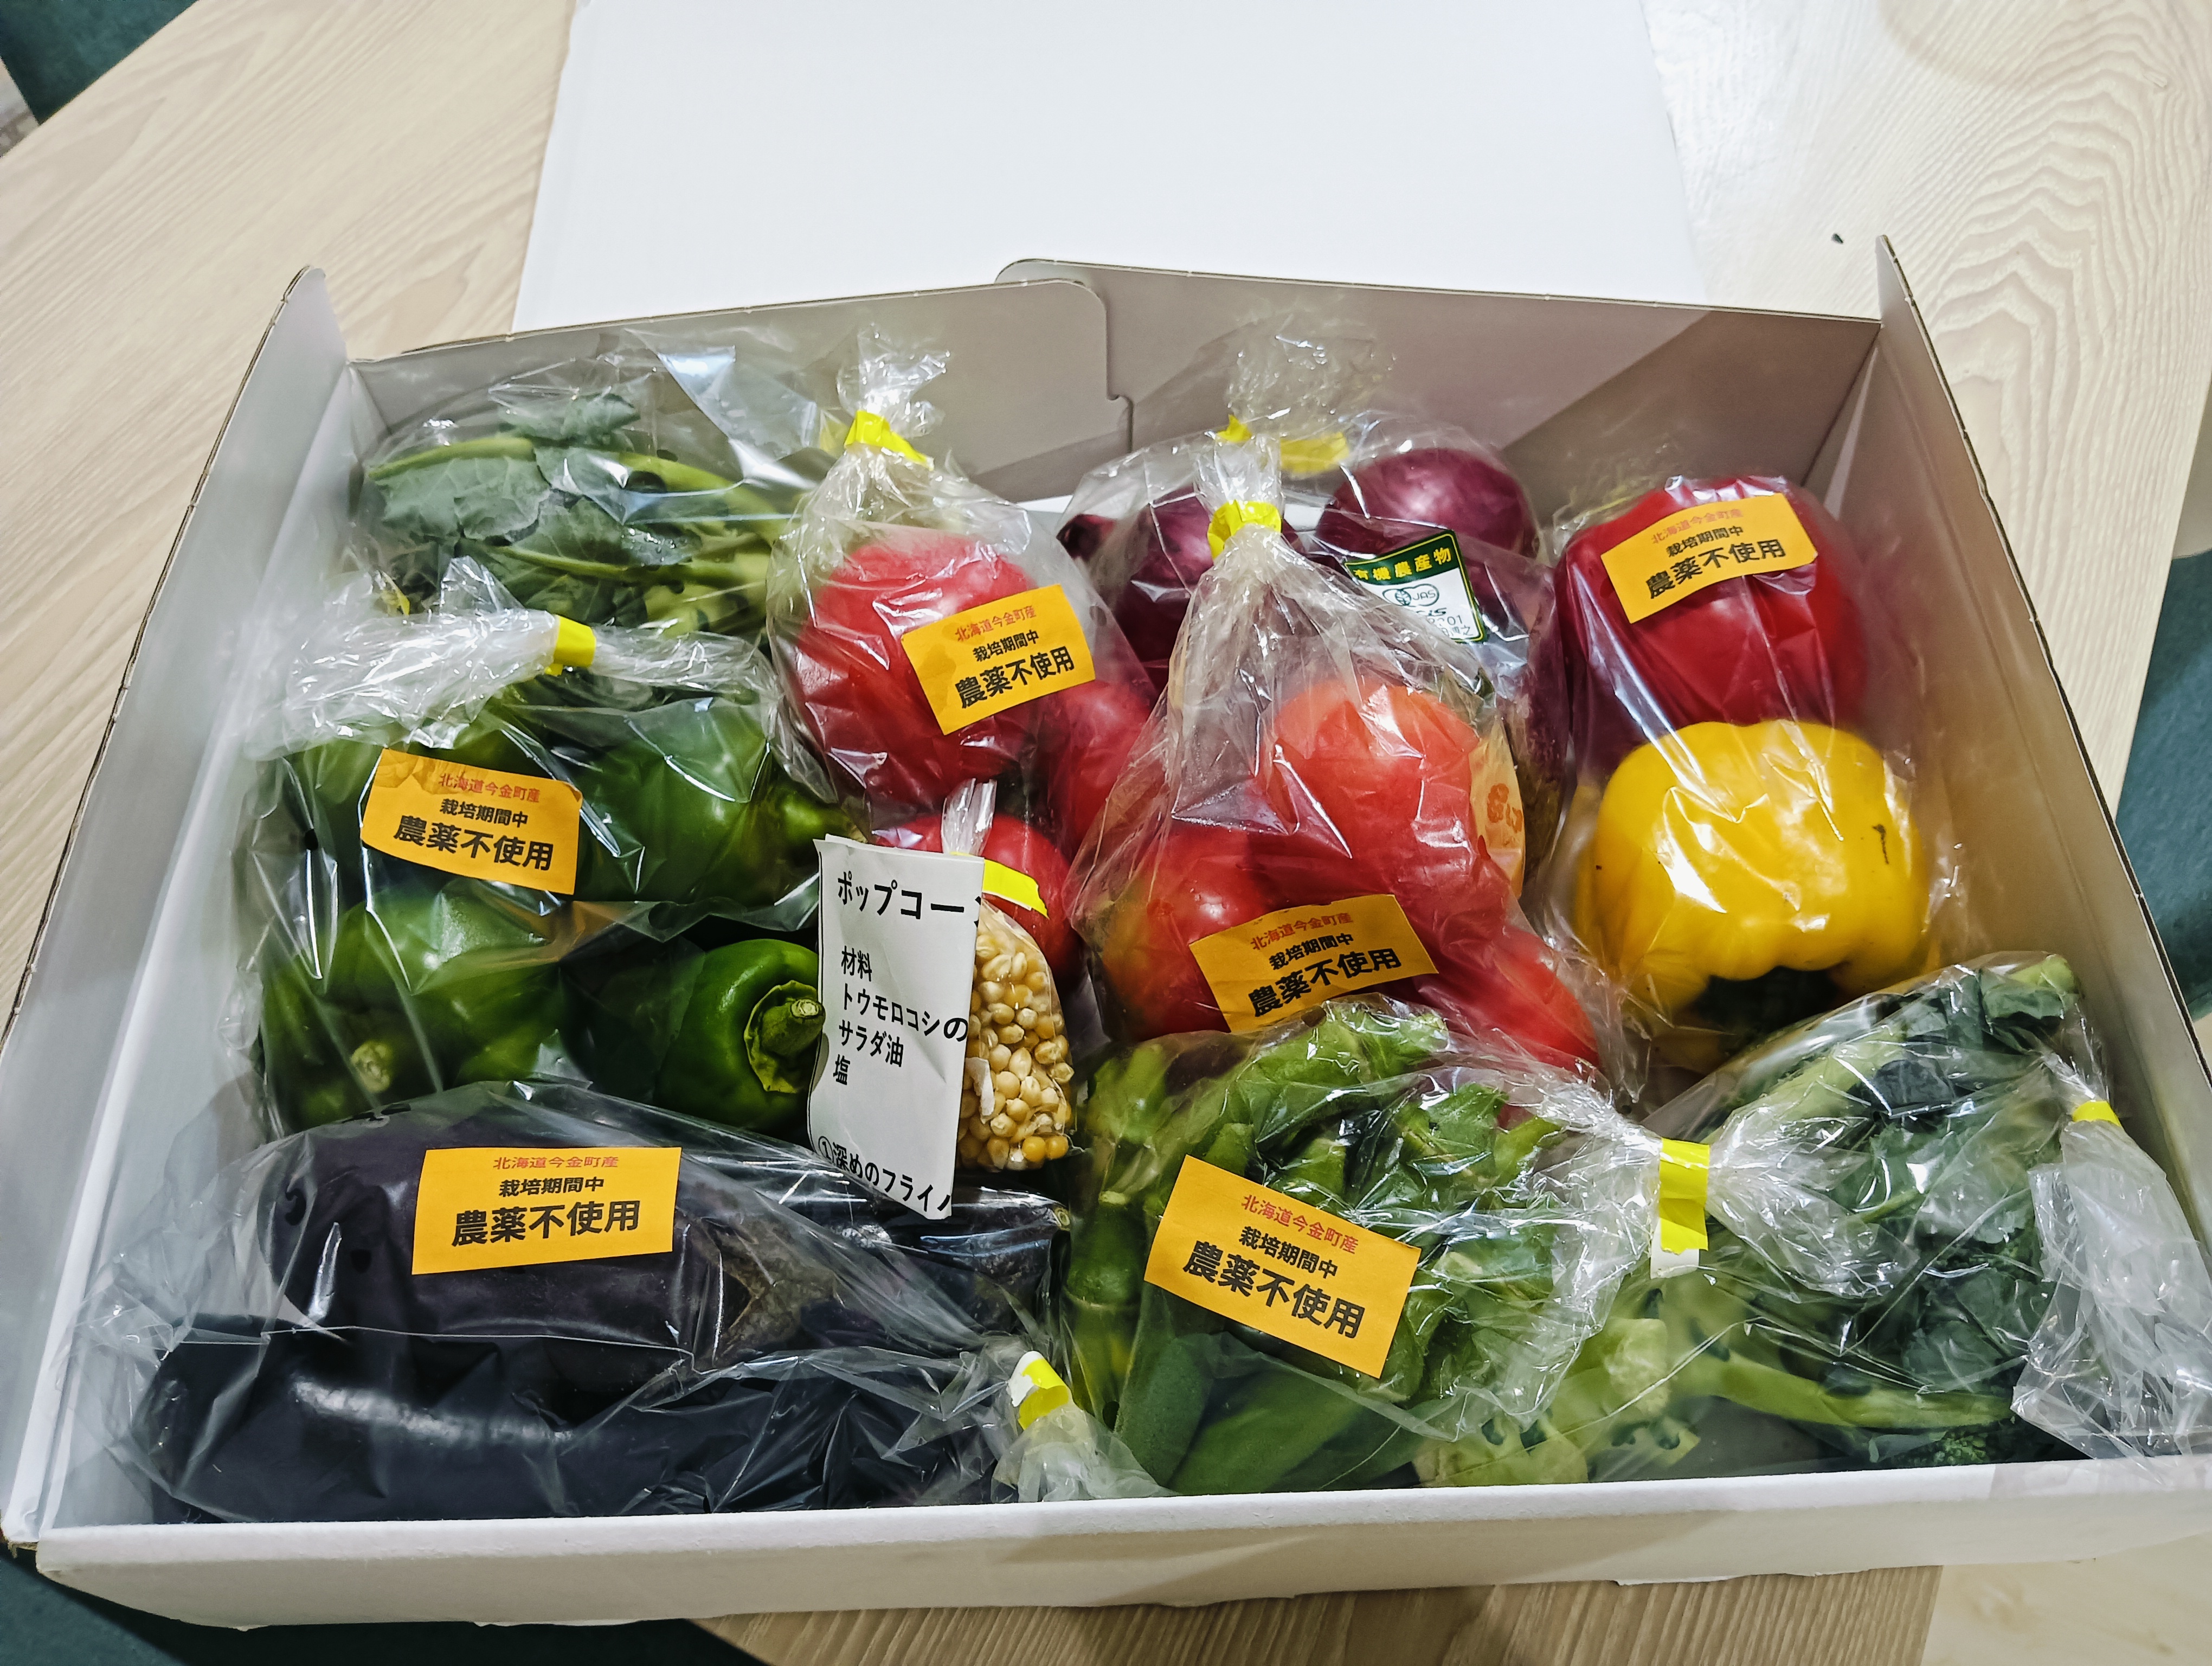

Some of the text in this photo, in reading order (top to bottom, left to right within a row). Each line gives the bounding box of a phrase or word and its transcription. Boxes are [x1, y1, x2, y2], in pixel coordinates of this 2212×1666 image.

[1650, 508, 1744, 544] 北海道今金町産
[1665, 526, 1744, 558] 栽培期間中
[1353, 547, 1452, 581] 有機農産物
[1645, 539, 1786, 599] 農薬不使用
[1412, 589, 1436, 601] JAS
[954, 605, 1037, 642] 北海道今金町産
[972, 629, 1039, 662] 栽培期間中
[955, 646, 1075, 709] 農薬不使用
[438, 772, 541, 803] 北海道今金町産
[440, 798, 528, 828] 栽培期間中
[393, 815, 553, 871] 農薬不使用
[838, 870, 981, 928] ポップコー
[1250, 912, 1354, 951] 北海道今金町産
[841, 945, 872, 982] 材料
[1268, 933, 1354, 970] 栽培期間中
[1248, 947, 1401, 1017] 農薬不使用
[844, 983, 968, 1042] トウモロコシの
[839, 1019, 904, 1067] サラダ油
[833, 1054, 851, 1085] 塩
[493, 1156, 619, 1170] 北海道今金町産
[498, 1176, 605, 1197] 栽培期間中
[451, 1200, 640, 1247] 農薬不使用
[1240, 1194, 1359, 1254] 北海道今金町産
[1238, 1226, 1338, 1279] 栽培期間中
[1182, 1240, 1365, 1339] 農薬不使用
